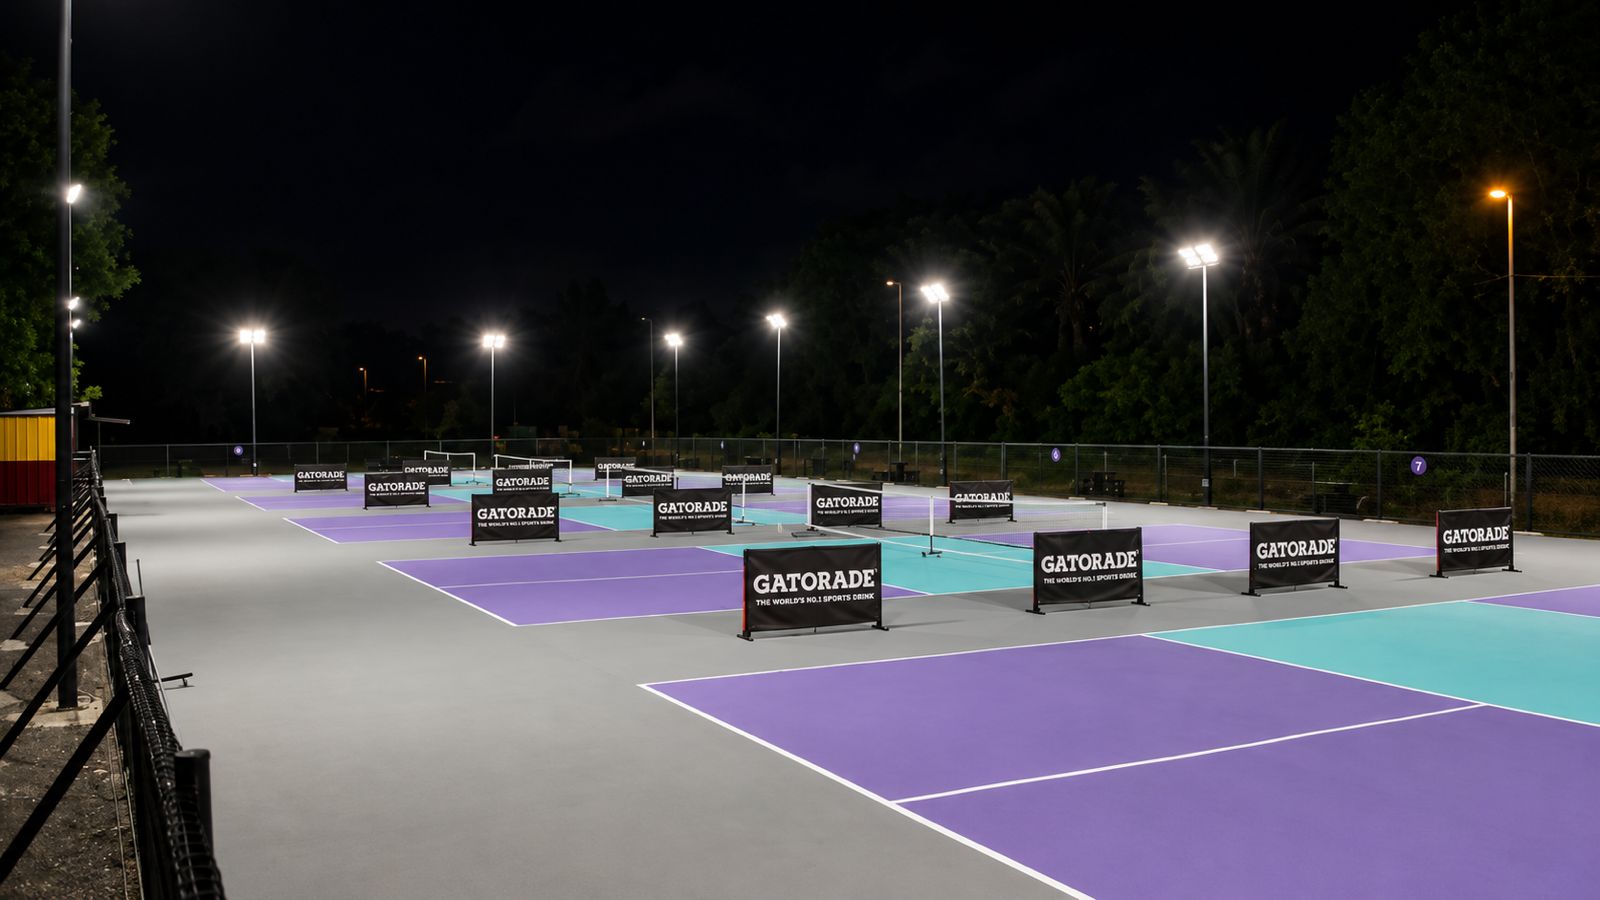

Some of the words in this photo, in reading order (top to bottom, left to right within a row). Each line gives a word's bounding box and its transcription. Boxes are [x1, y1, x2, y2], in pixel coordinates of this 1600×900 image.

[1415, 461, 1423, 472] 7
[297, 470, 345, 479] GATORADE
[625, 473, 672, 483] GATORADE
[367, 481, 426, 492] GATORADE
[495, 477, 550, 487] GATORADE
[657, 501, 728, 514] GATORADE
[816, 496, 879, 508] GATORADE
[477, 506, 555, 520] GATORADE
[1443, 526, 1510, 545] GATORADE
[1256, 539, 1336, 560] GATORADE
[1041, 551, 1137, 573] GATORADE
[753, 569, 875, 594] GATORADE
[1056, 576, 1082, 584] WORLD'S
[756, 598, 771, 606] THE
[773, 597, 805, 605] WORLD'S
[823, 594, 852, 602] SPORTS
[852, 593, 875, 601] DRINK
